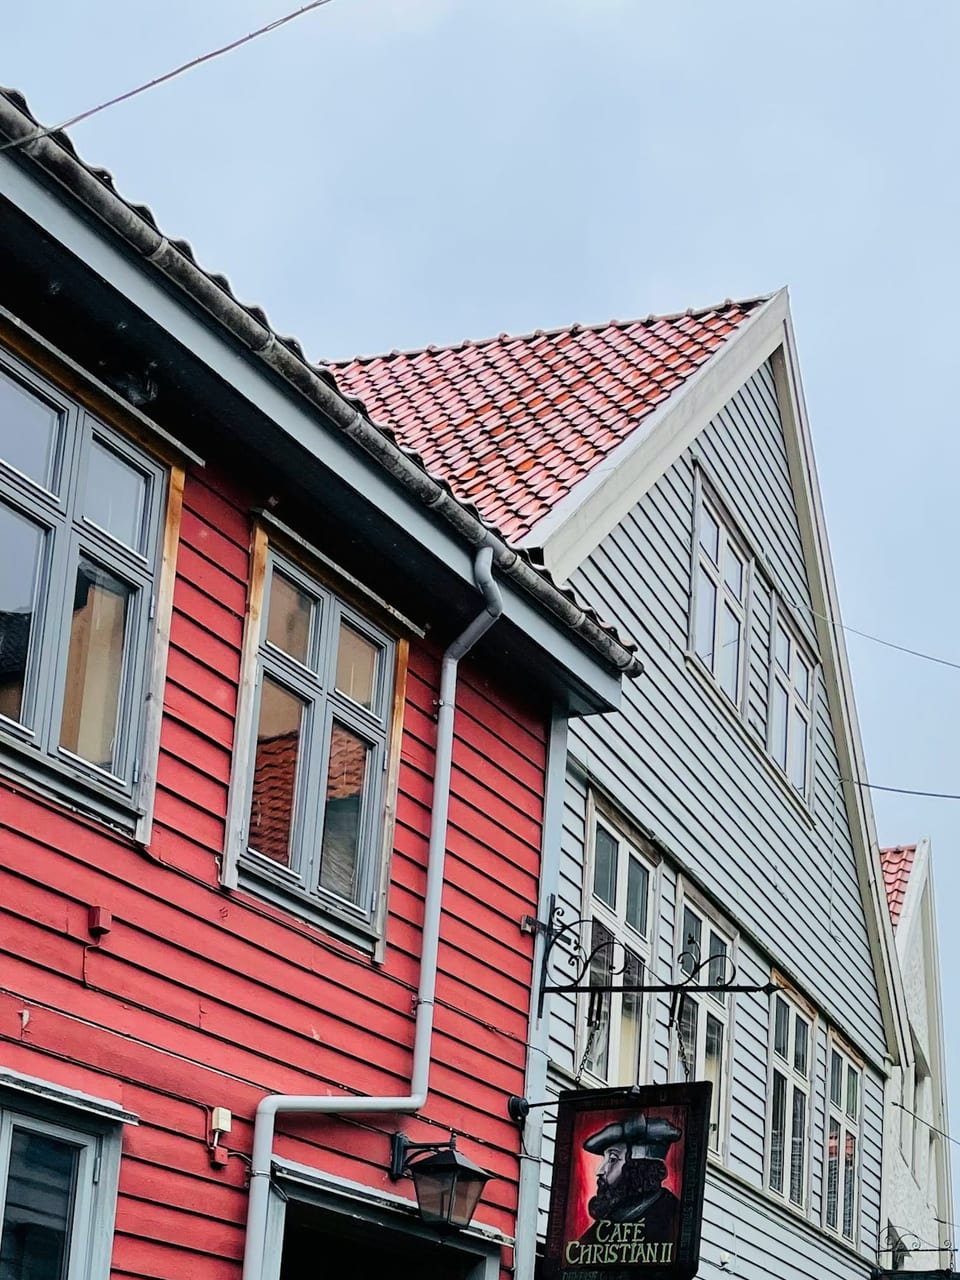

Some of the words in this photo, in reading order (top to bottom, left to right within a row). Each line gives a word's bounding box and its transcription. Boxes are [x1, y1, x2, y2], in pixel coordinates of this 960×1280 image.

[596, 1217, 646, 1243] CAFÉ
[565, 1240, 659, 1264] CHRISTIAN
[660, 1242, 674, 1263] II
